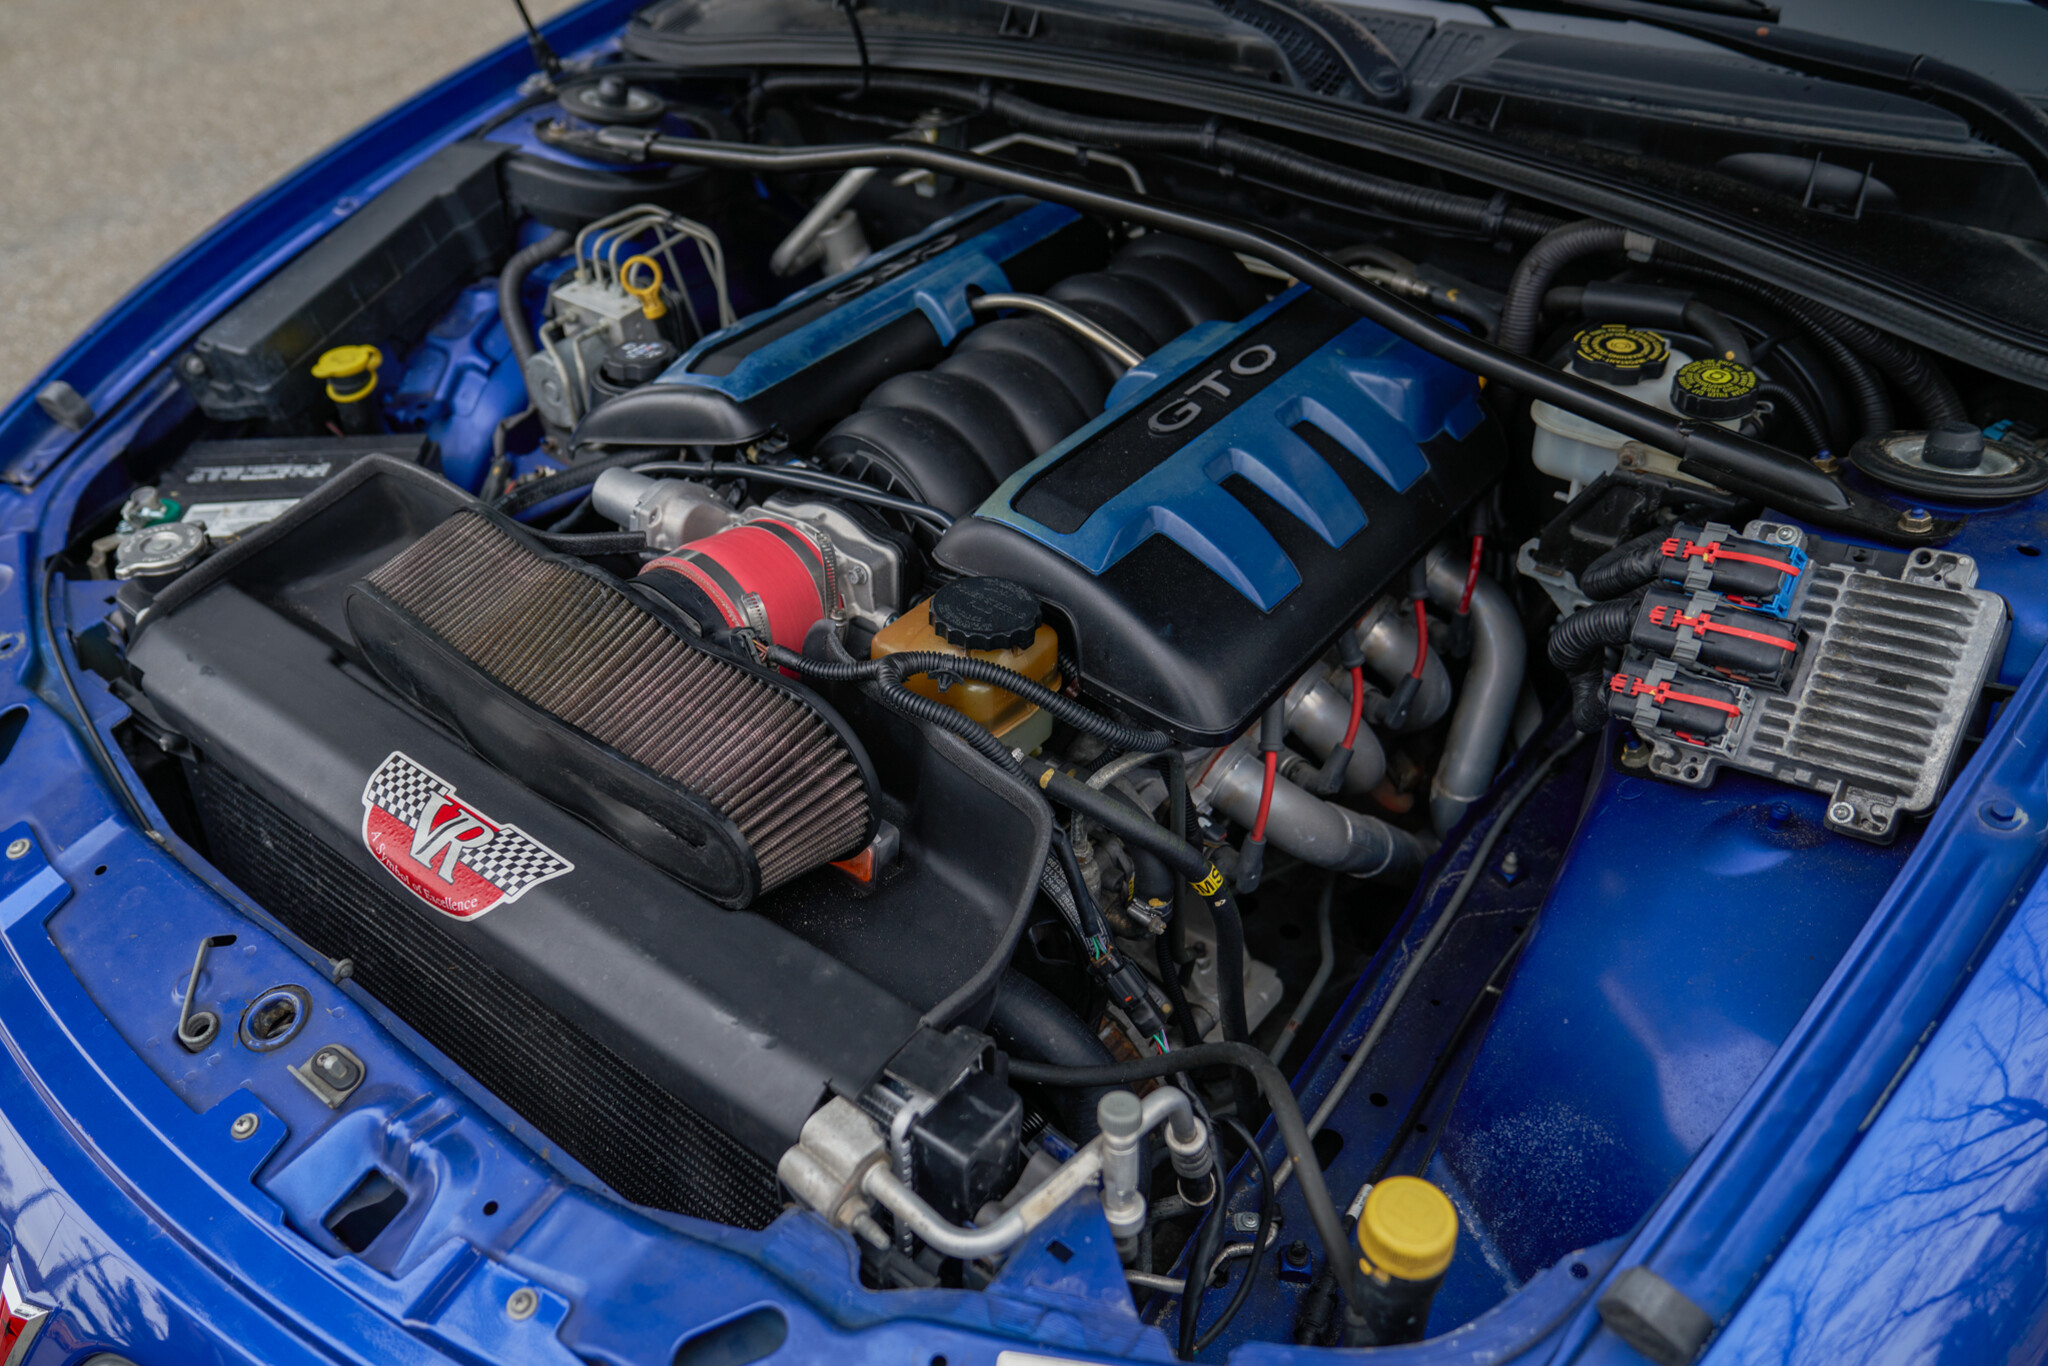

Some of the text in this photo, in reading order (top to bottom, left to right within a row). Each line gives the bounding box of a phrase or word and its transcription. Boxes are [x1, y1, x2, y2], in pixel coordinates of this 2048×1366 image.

[1147, 344, 1277, 434] GTO
[371, 832, 478, 911] A Symbol of Excellence
[409, 790, 495, 885] VR
